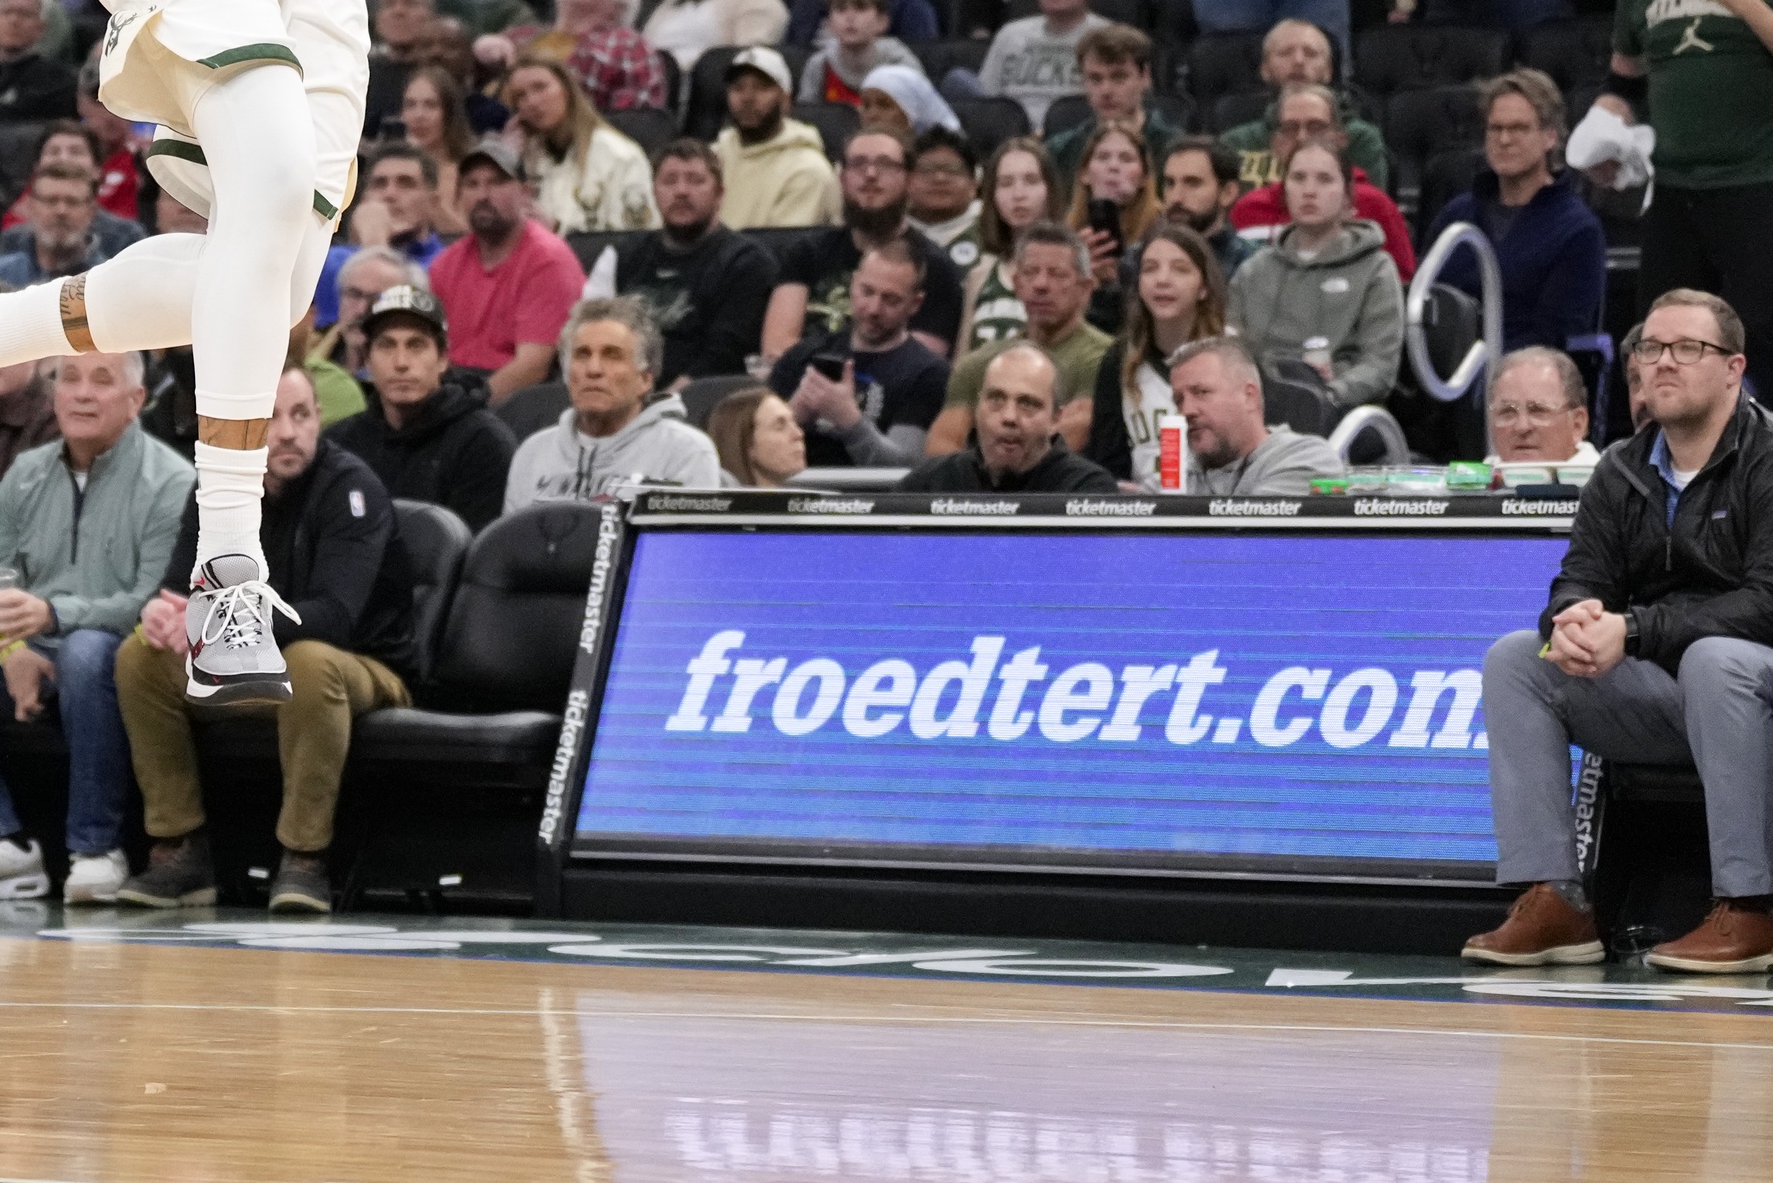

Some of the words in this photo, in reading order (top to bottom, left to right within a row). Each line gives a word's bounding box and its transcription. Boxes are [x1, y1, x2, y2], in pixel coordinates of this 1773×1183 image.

[647, 496, 732, 512] ticketmaster
[787, 498, 876, 514] ticketmaster
[930, 499, 1020, 516] ticketmaster
[1065, 499, 1157, 516] ticketmaster
[1208, 500, 1302, 516] ticketmaster
[1353, 498, 1449, 516] ticketmaster
[580, 503, 618, 654] ticketmaster
[538, 689, 589, 846] ticketmaster
